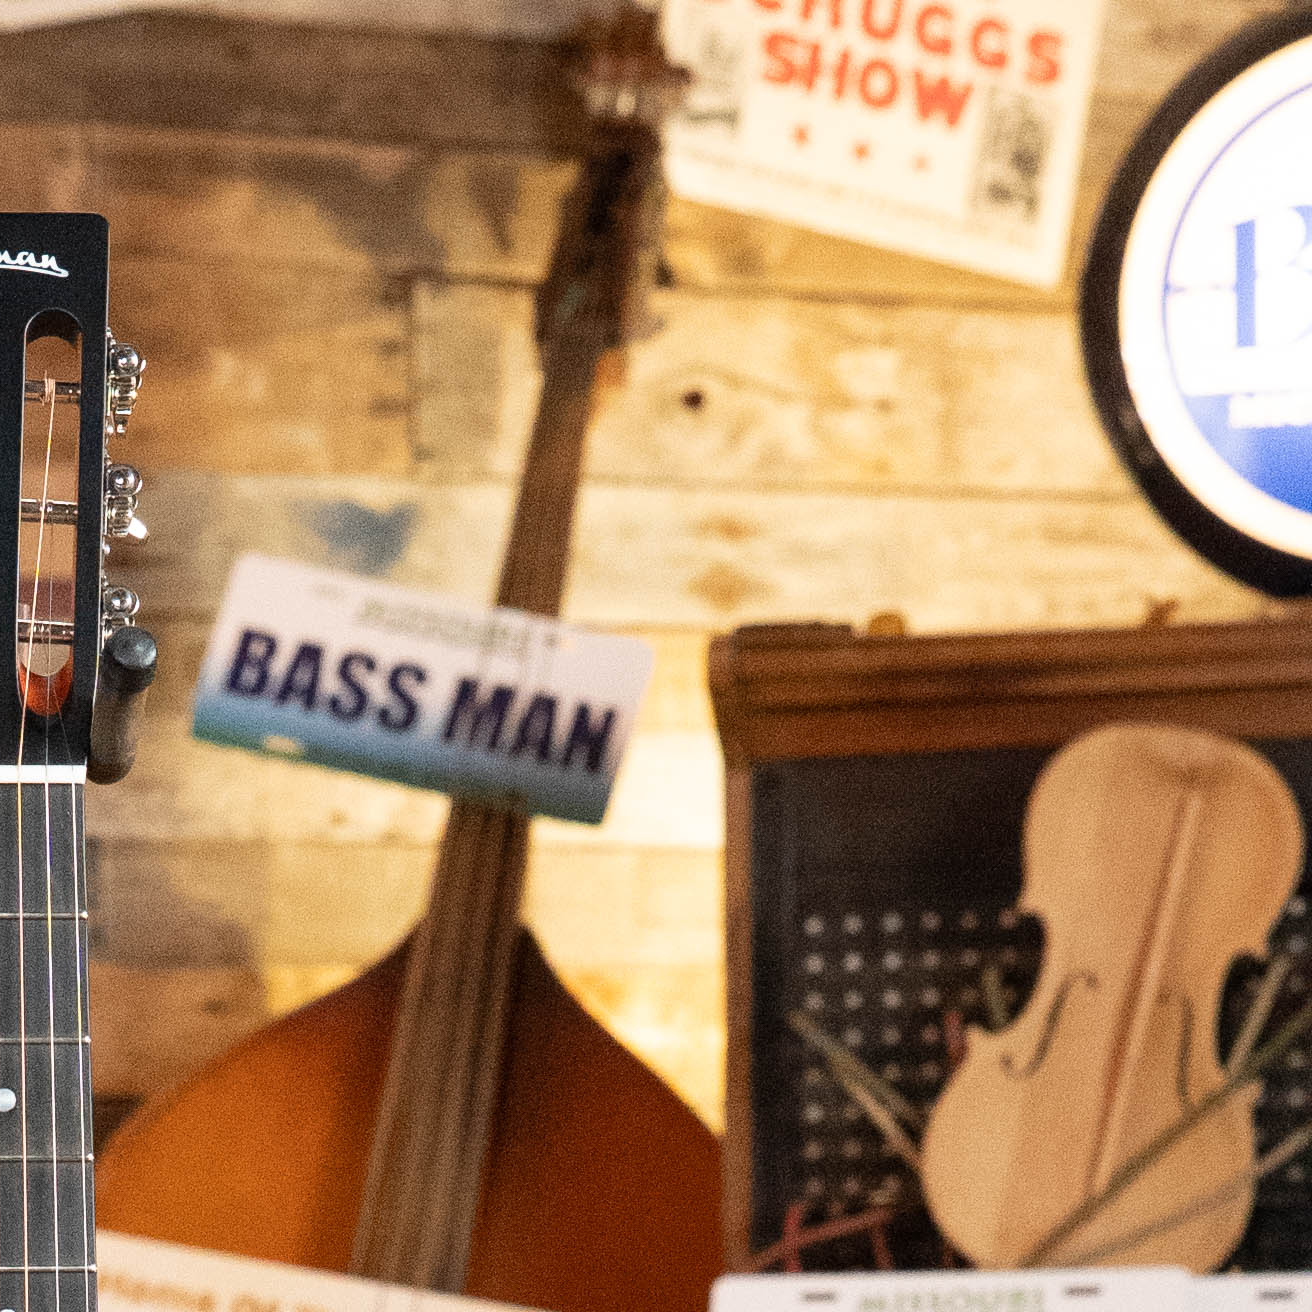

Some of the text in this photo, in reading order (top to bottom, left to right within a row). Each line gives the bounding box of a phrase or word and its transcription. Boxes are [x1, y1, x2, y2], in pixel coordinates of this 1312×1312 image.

[750, 0, 1065, 87] UGGS
[761, 29, 974, 132] SHOW
[225, 627, 617, 773] BASS MAN
